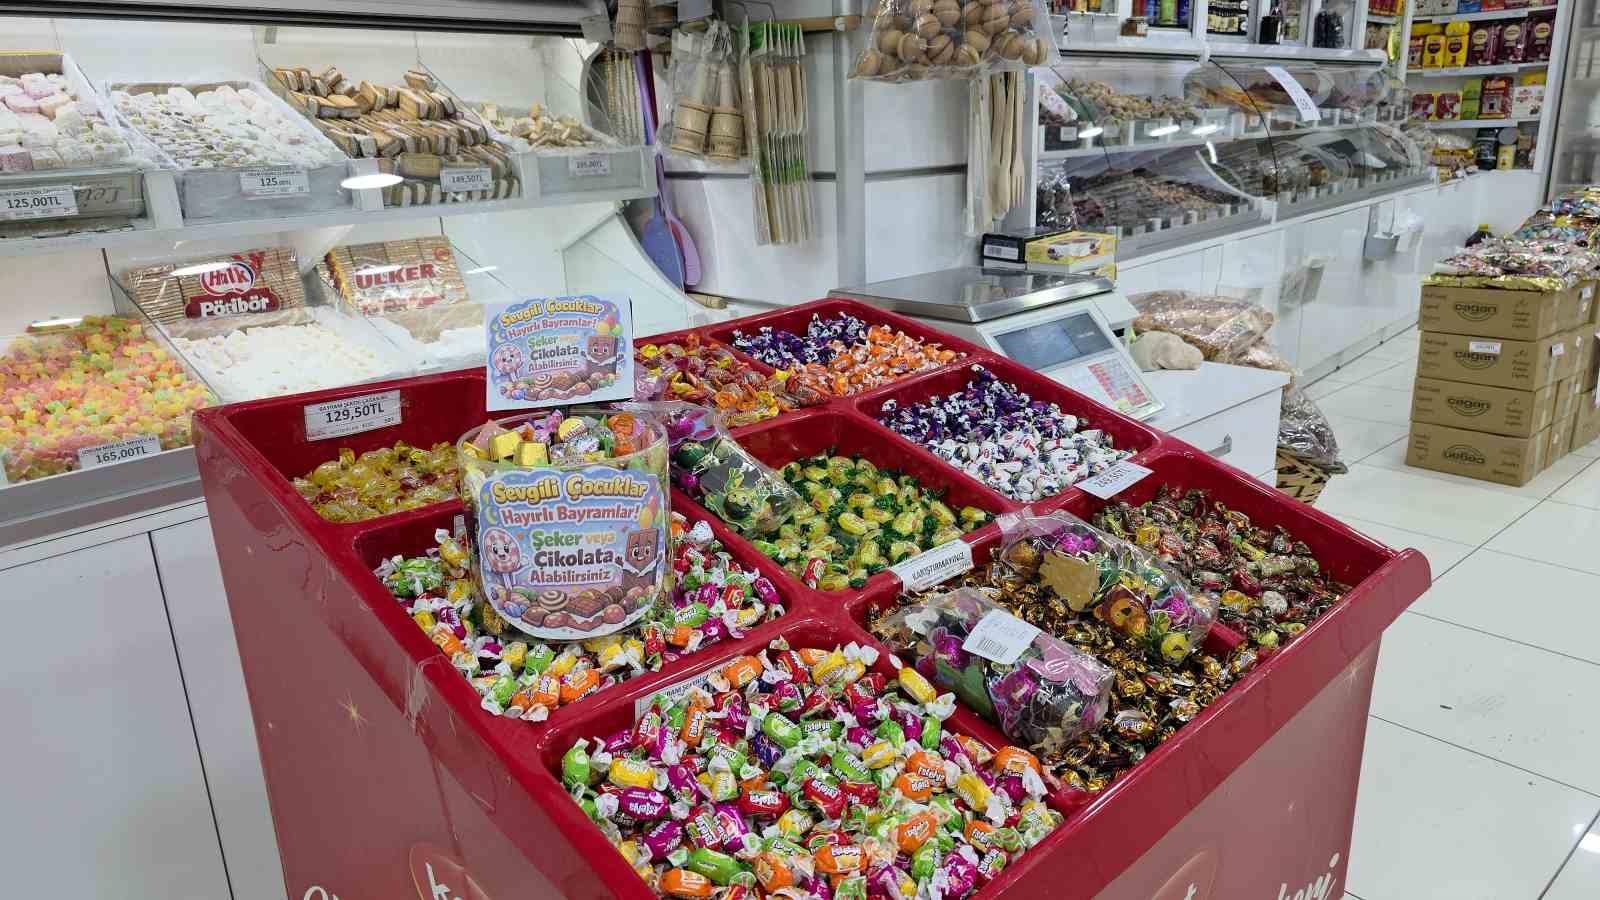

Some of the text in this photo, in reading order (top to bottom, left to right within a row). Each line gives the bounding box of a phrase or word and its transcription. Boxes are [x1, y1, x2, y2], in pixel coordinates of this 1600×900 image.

[7, 197, 61, 209] 125,00TL
[501, 300, 603, 326] Sevgili Çocuklar
[508, 319, 597, 339] Hayırlı Bayramlar!
[528, 335, 557, 347] Şeker
[530, 345, 579, 362] Çikolata
[528, 359, 577, 372] Alabilirsiniz
[326, 402, 385, 423] 129,50TL
[96, 446, 148, 464] 165,00TL
[493, 475, 648, 505] Sevgili Çocuklar
[502, 504, 640, 526] Hayırlı Bayramlar!
[532, 530, 616, 550] Şeker veya
[534, 549, 614, 571] Çikolata
[530, 569, 611, 584] Alabilirsiniz
